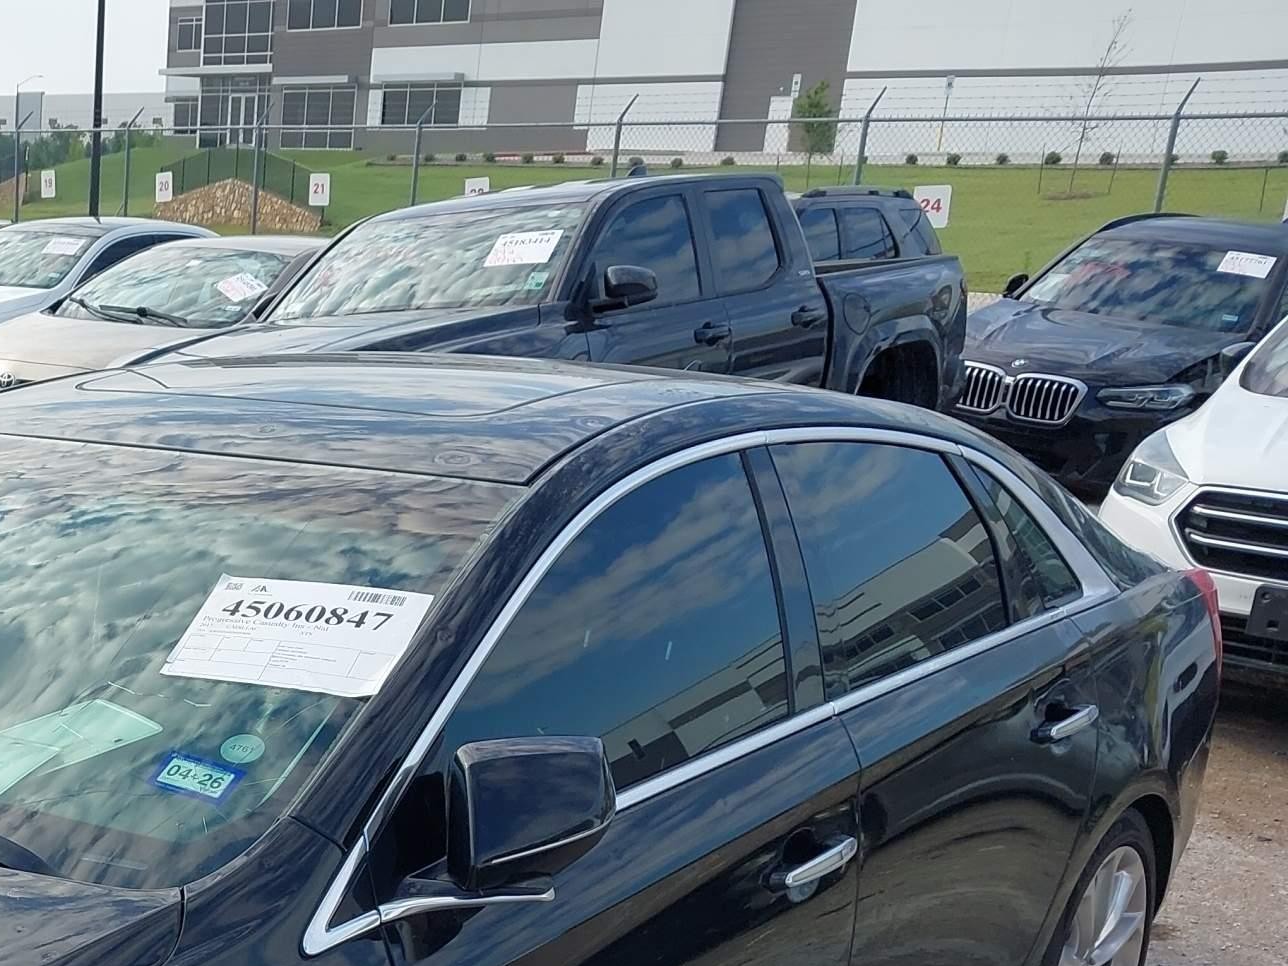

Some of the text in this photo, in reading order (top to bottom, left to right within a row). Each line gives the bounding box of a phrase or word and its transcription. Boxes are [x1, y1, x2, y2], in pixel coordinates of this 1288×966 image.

[159, 181, 170, 191] 20
[313, 183, 325, 194] 21
[920, 198, 942, 213] 24
[221, 599, 394, 632] 45060847
[197, 773, 225, 790] 26
